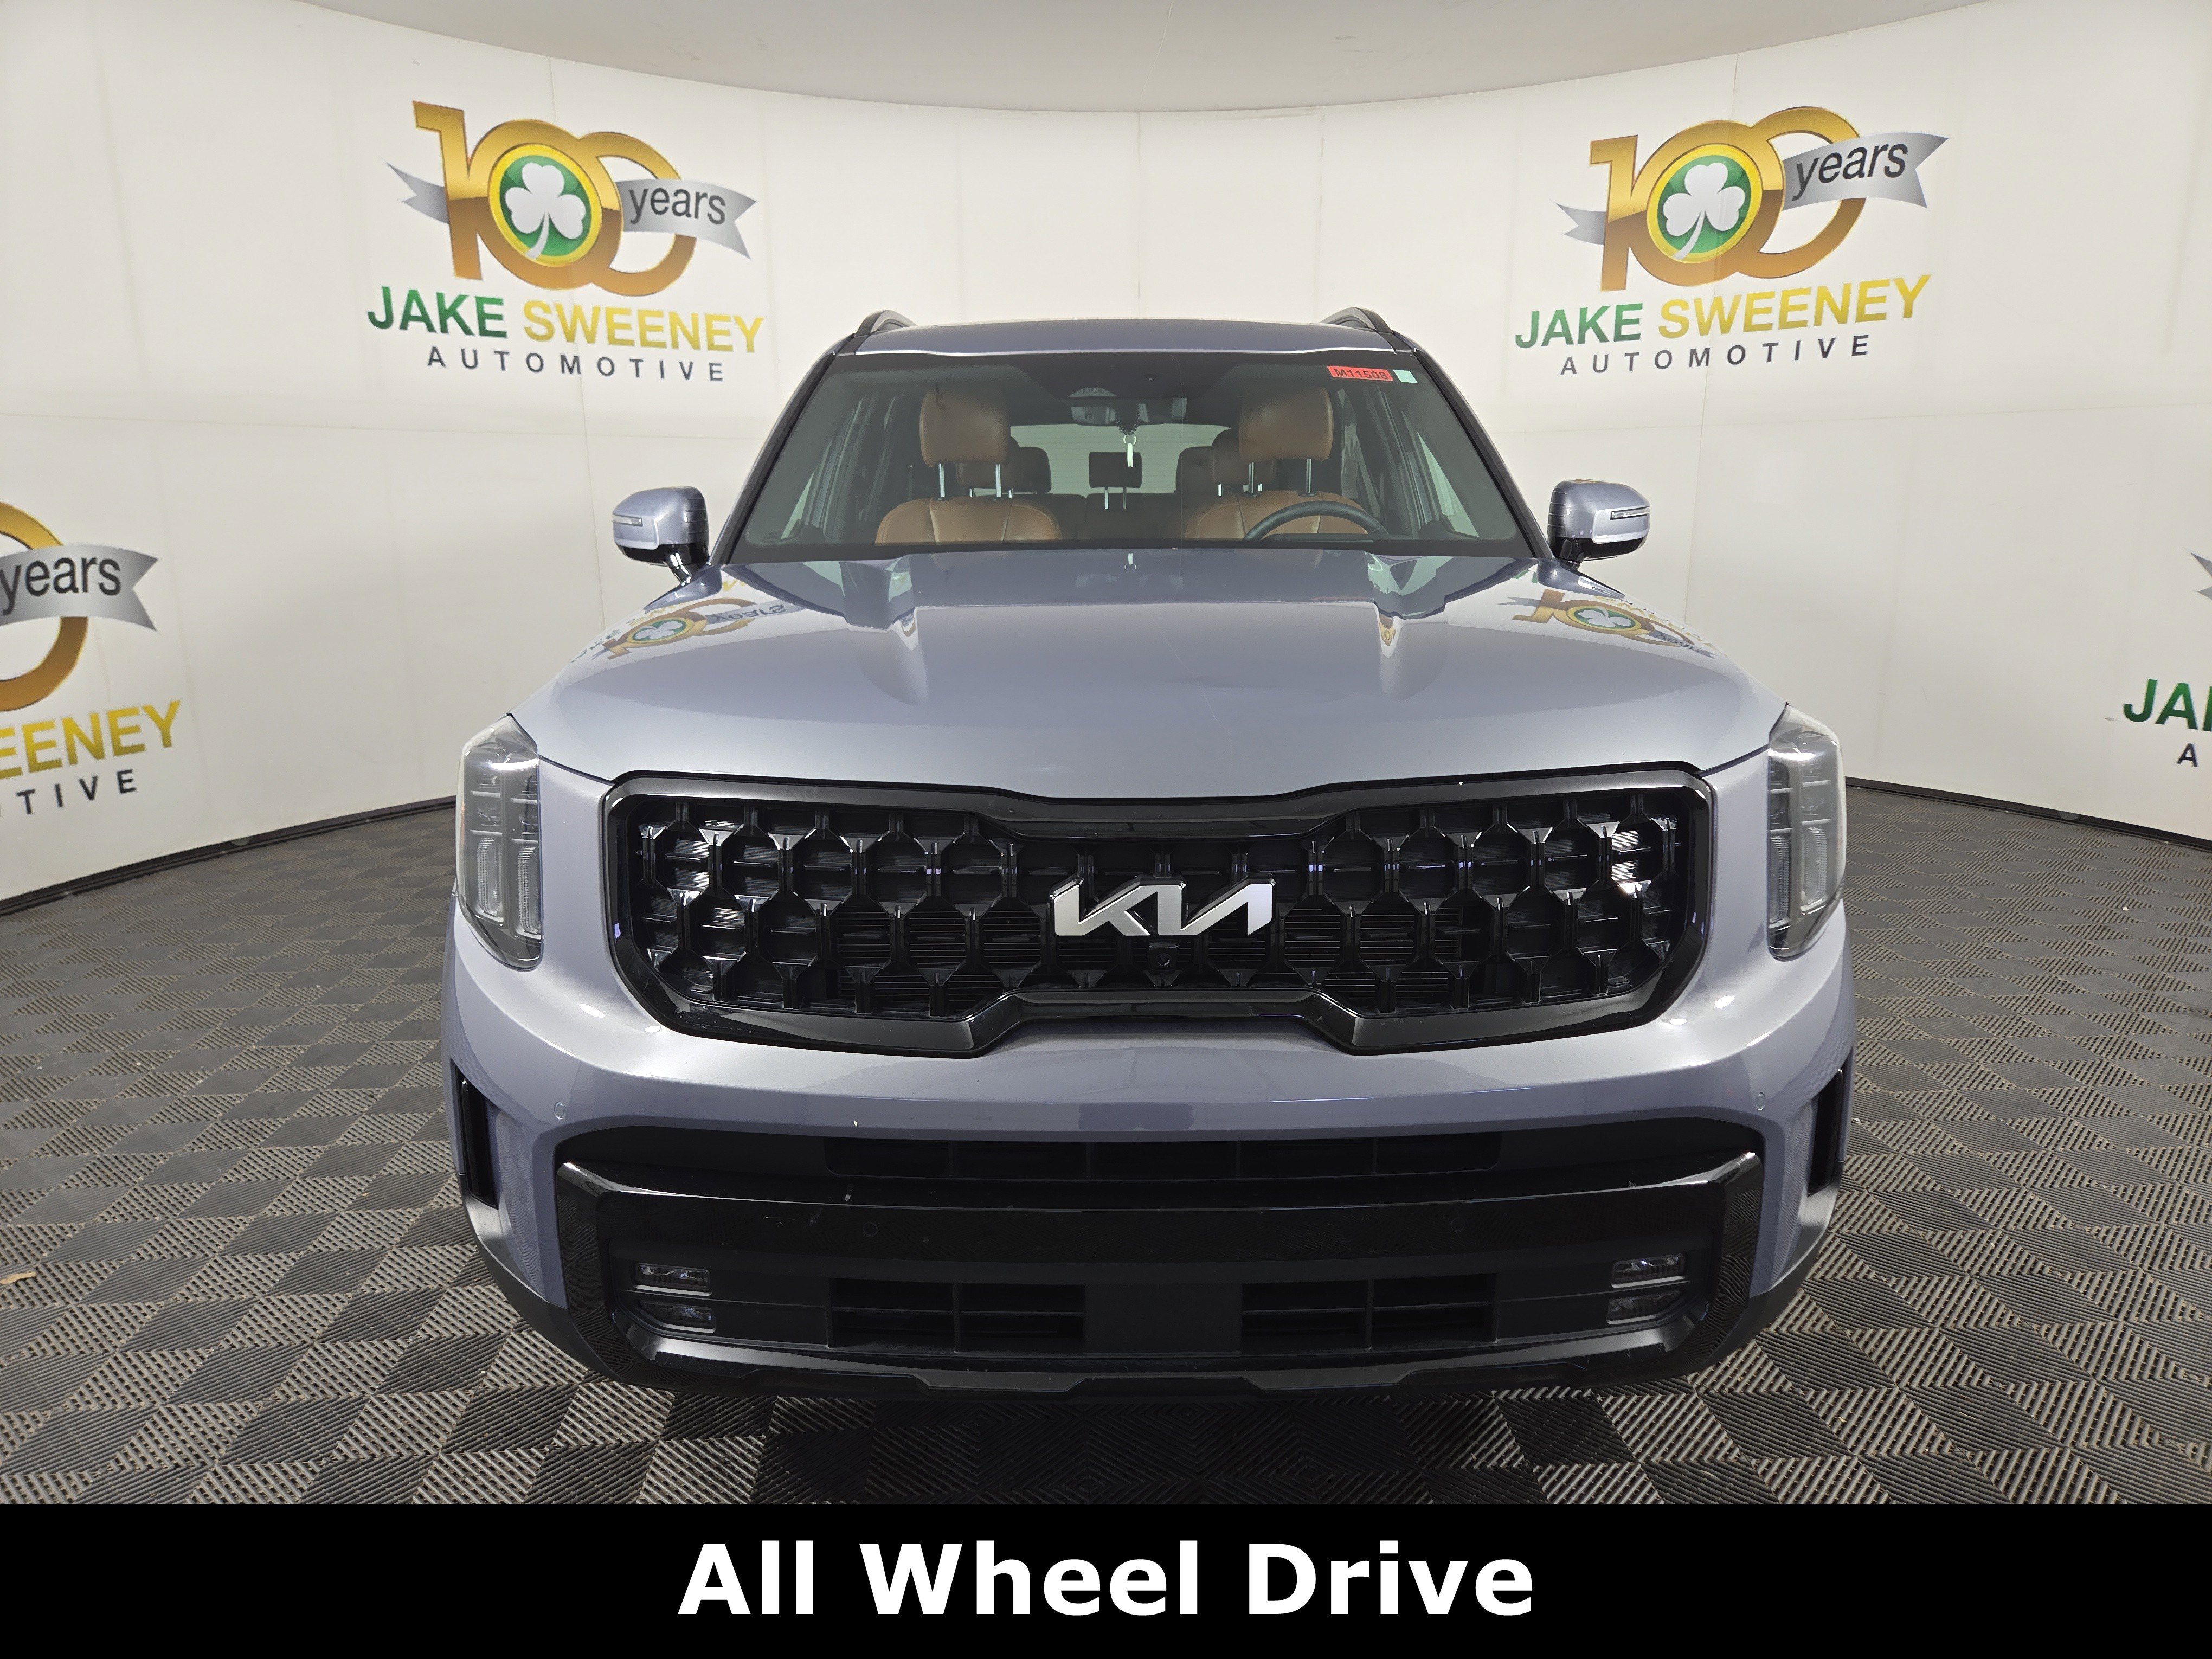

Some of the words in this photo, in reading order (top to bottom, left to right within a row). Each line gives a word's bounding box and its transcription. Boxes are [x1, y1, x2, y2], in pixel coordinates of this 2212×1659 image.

[413, 100, 697, 297] 100
[629, 188, 726, 225] years
[1590, 106, 1867, 292] 100
[1791, 143, 1908, 201] years
[367, 286, 509, 339] JAKE
[523, 300, 764, 353] SWEENEY
[1515, 303, 1643, 348] JAKE
[1658, 274, 1932, 339] SWEENEY
[427, 346, 724, 381] AUTOMOTIVE
[1333, 368, 1389, 380] M11508
[1560, 335, 1869, 375] AUTOMOTIVE
[0, 557, 121, 615] years
[0, 769, 136, 818] TIVE
[1051, 877, 1275, 936] KIA
